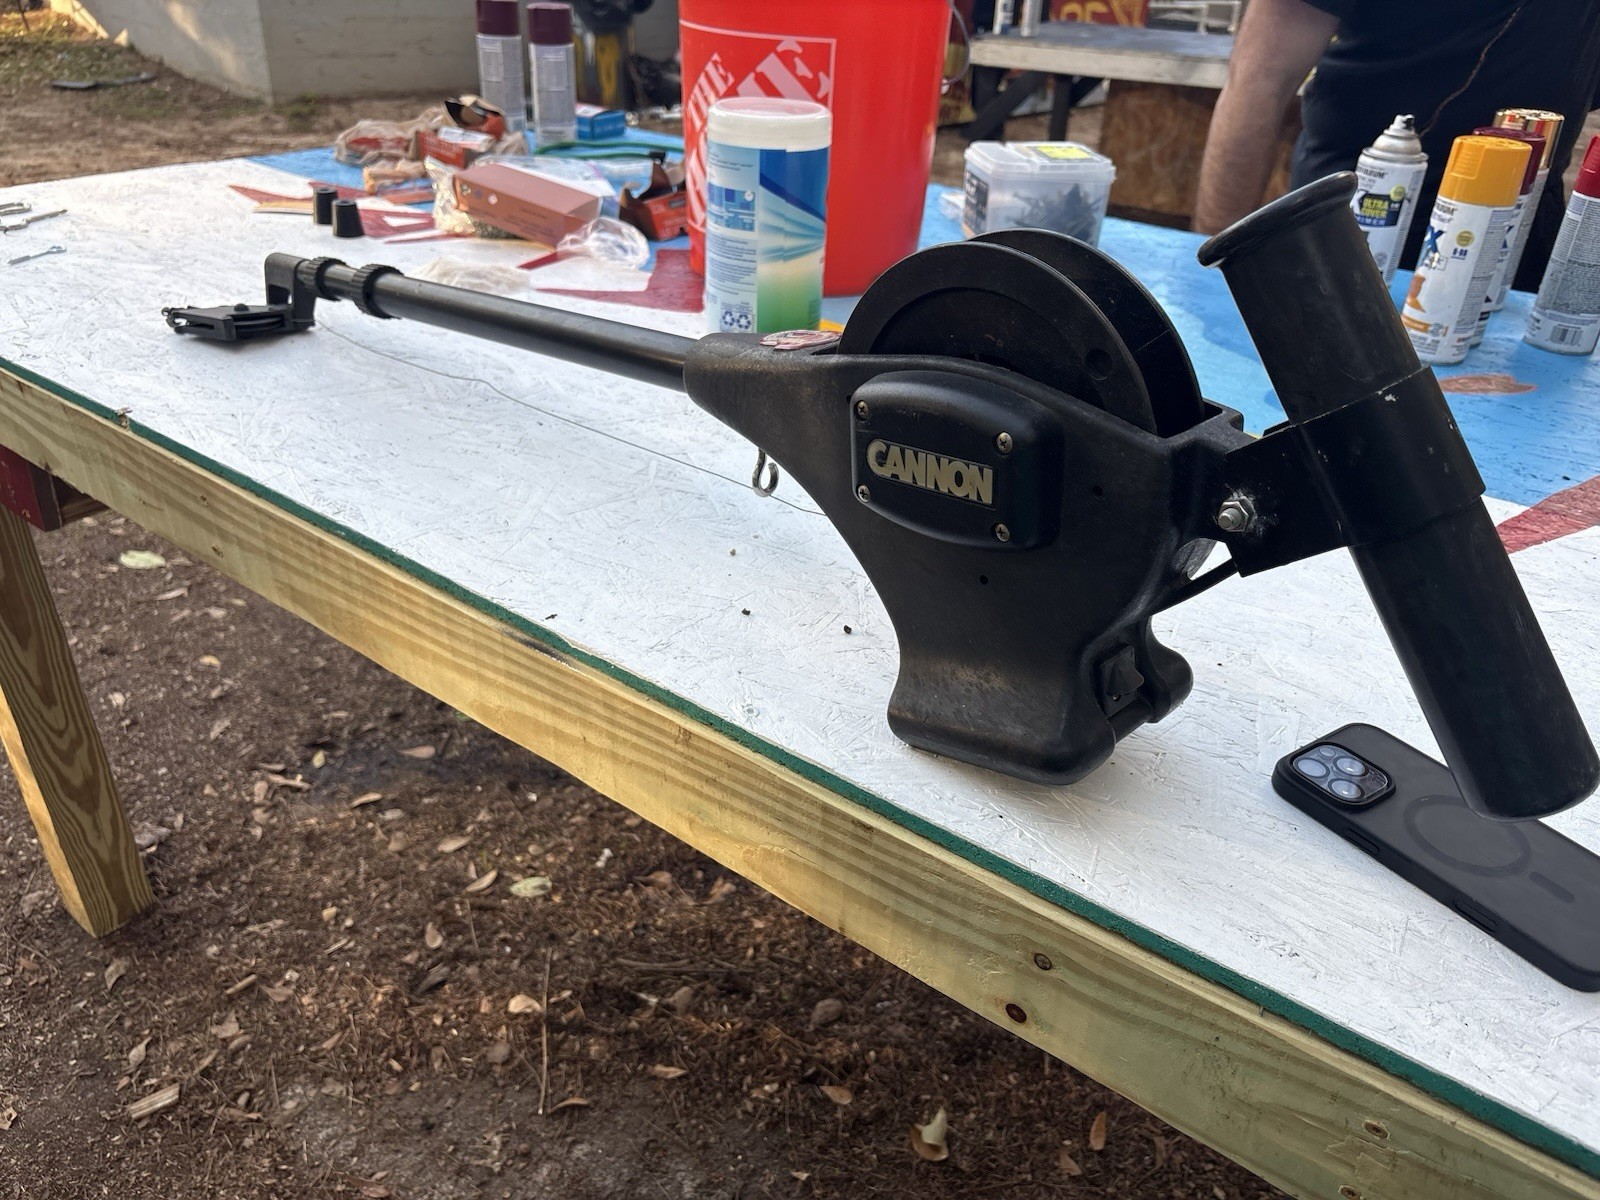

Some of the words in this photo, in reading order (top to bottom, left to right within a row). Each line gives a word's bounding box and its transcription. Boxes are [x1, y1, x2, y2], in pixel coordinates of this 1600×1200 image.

[686, 52, 735, 132] THE
[1362, 197, 1389, 211] ULTRA
[866, 440, 993, 505] CANNON
